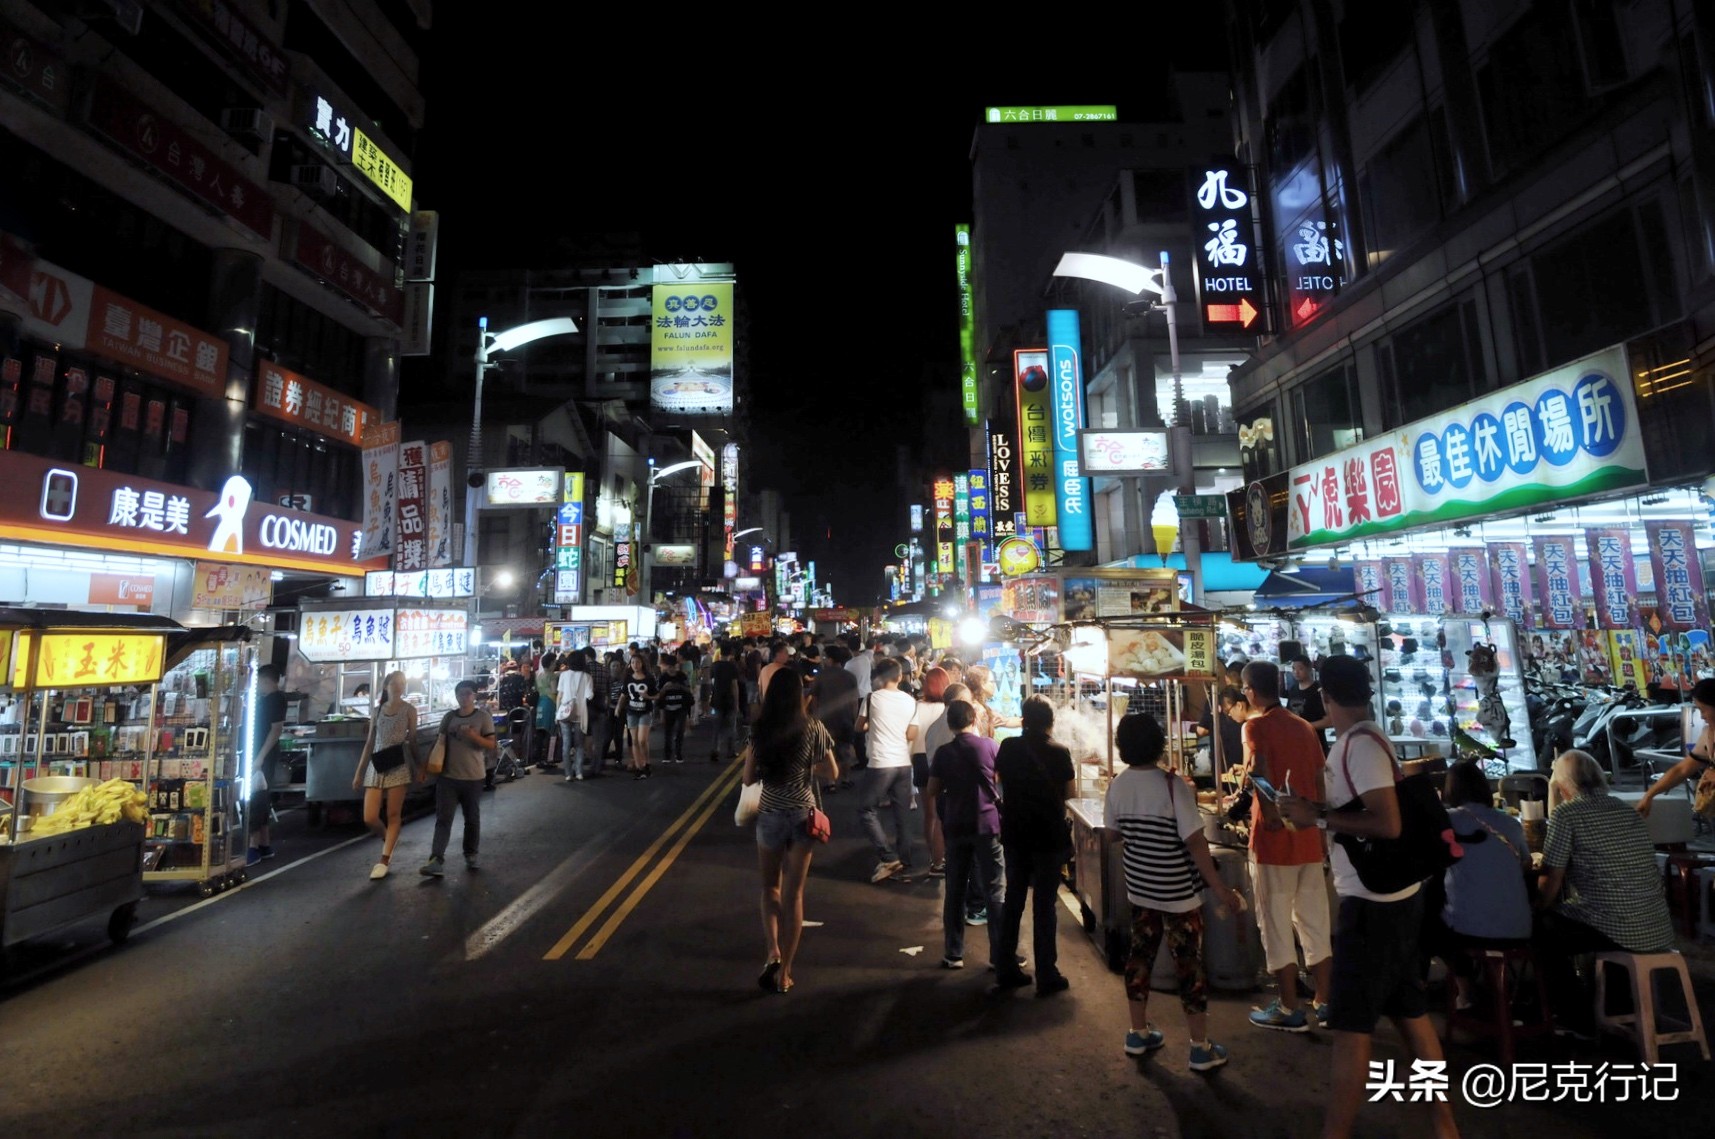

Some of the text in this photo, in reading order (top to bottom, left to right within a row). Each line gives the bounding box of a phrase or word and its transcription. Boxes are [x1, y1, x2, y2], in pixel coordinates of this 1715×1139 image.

[316, 96, 351, 152] 實力
[1003, 109, 1057, 120] 六合日麗
[1197, 169, 1248, 268] 九福
[958, 249, 970, 316] Sunnyside Hotel
[1205, 277, 1252, 291] HOTEL
[104, 303, 218, 374] 臺灣企銀
[656, 314, 726, 328] 法輪大法
[657, 344, 724, 352] www.falundafa.org
[146, 352, 190, 375] BUSINESS
[964, 362, 976, 418] 六合日麗
[264, 370, 357, 437] 證券經紀商
[1060, 359, 1074, 438] watsons
[1027, 403, 1048, 491] 台灣彩券
[1419, 378, 1615, 487] 最佳休閒場所
[996, 434, 1011, 511] LOVESS
[107, 486, 190, 534] 康是美
[364, 460, 382, 543] 烏魚子
[260, 514, 337, 555] COSMED
[130, 584, 153, 593] COSMED
[1499, 550, 1523, 624] 天天抽紅包
[1544, 543, 1574, 624] 天天抽紅包
[1599, 536, 1629, 624] 天天抽紅包
[1659, 529, 1696, 623] 天天抽紅包
[303, 614, 343, 646] 烏魚子
[339, 643, 351, 653] 50
[1190, 632, 1206, 668] 脆皮湯包
[73, 641, 129, 679] 玉米
